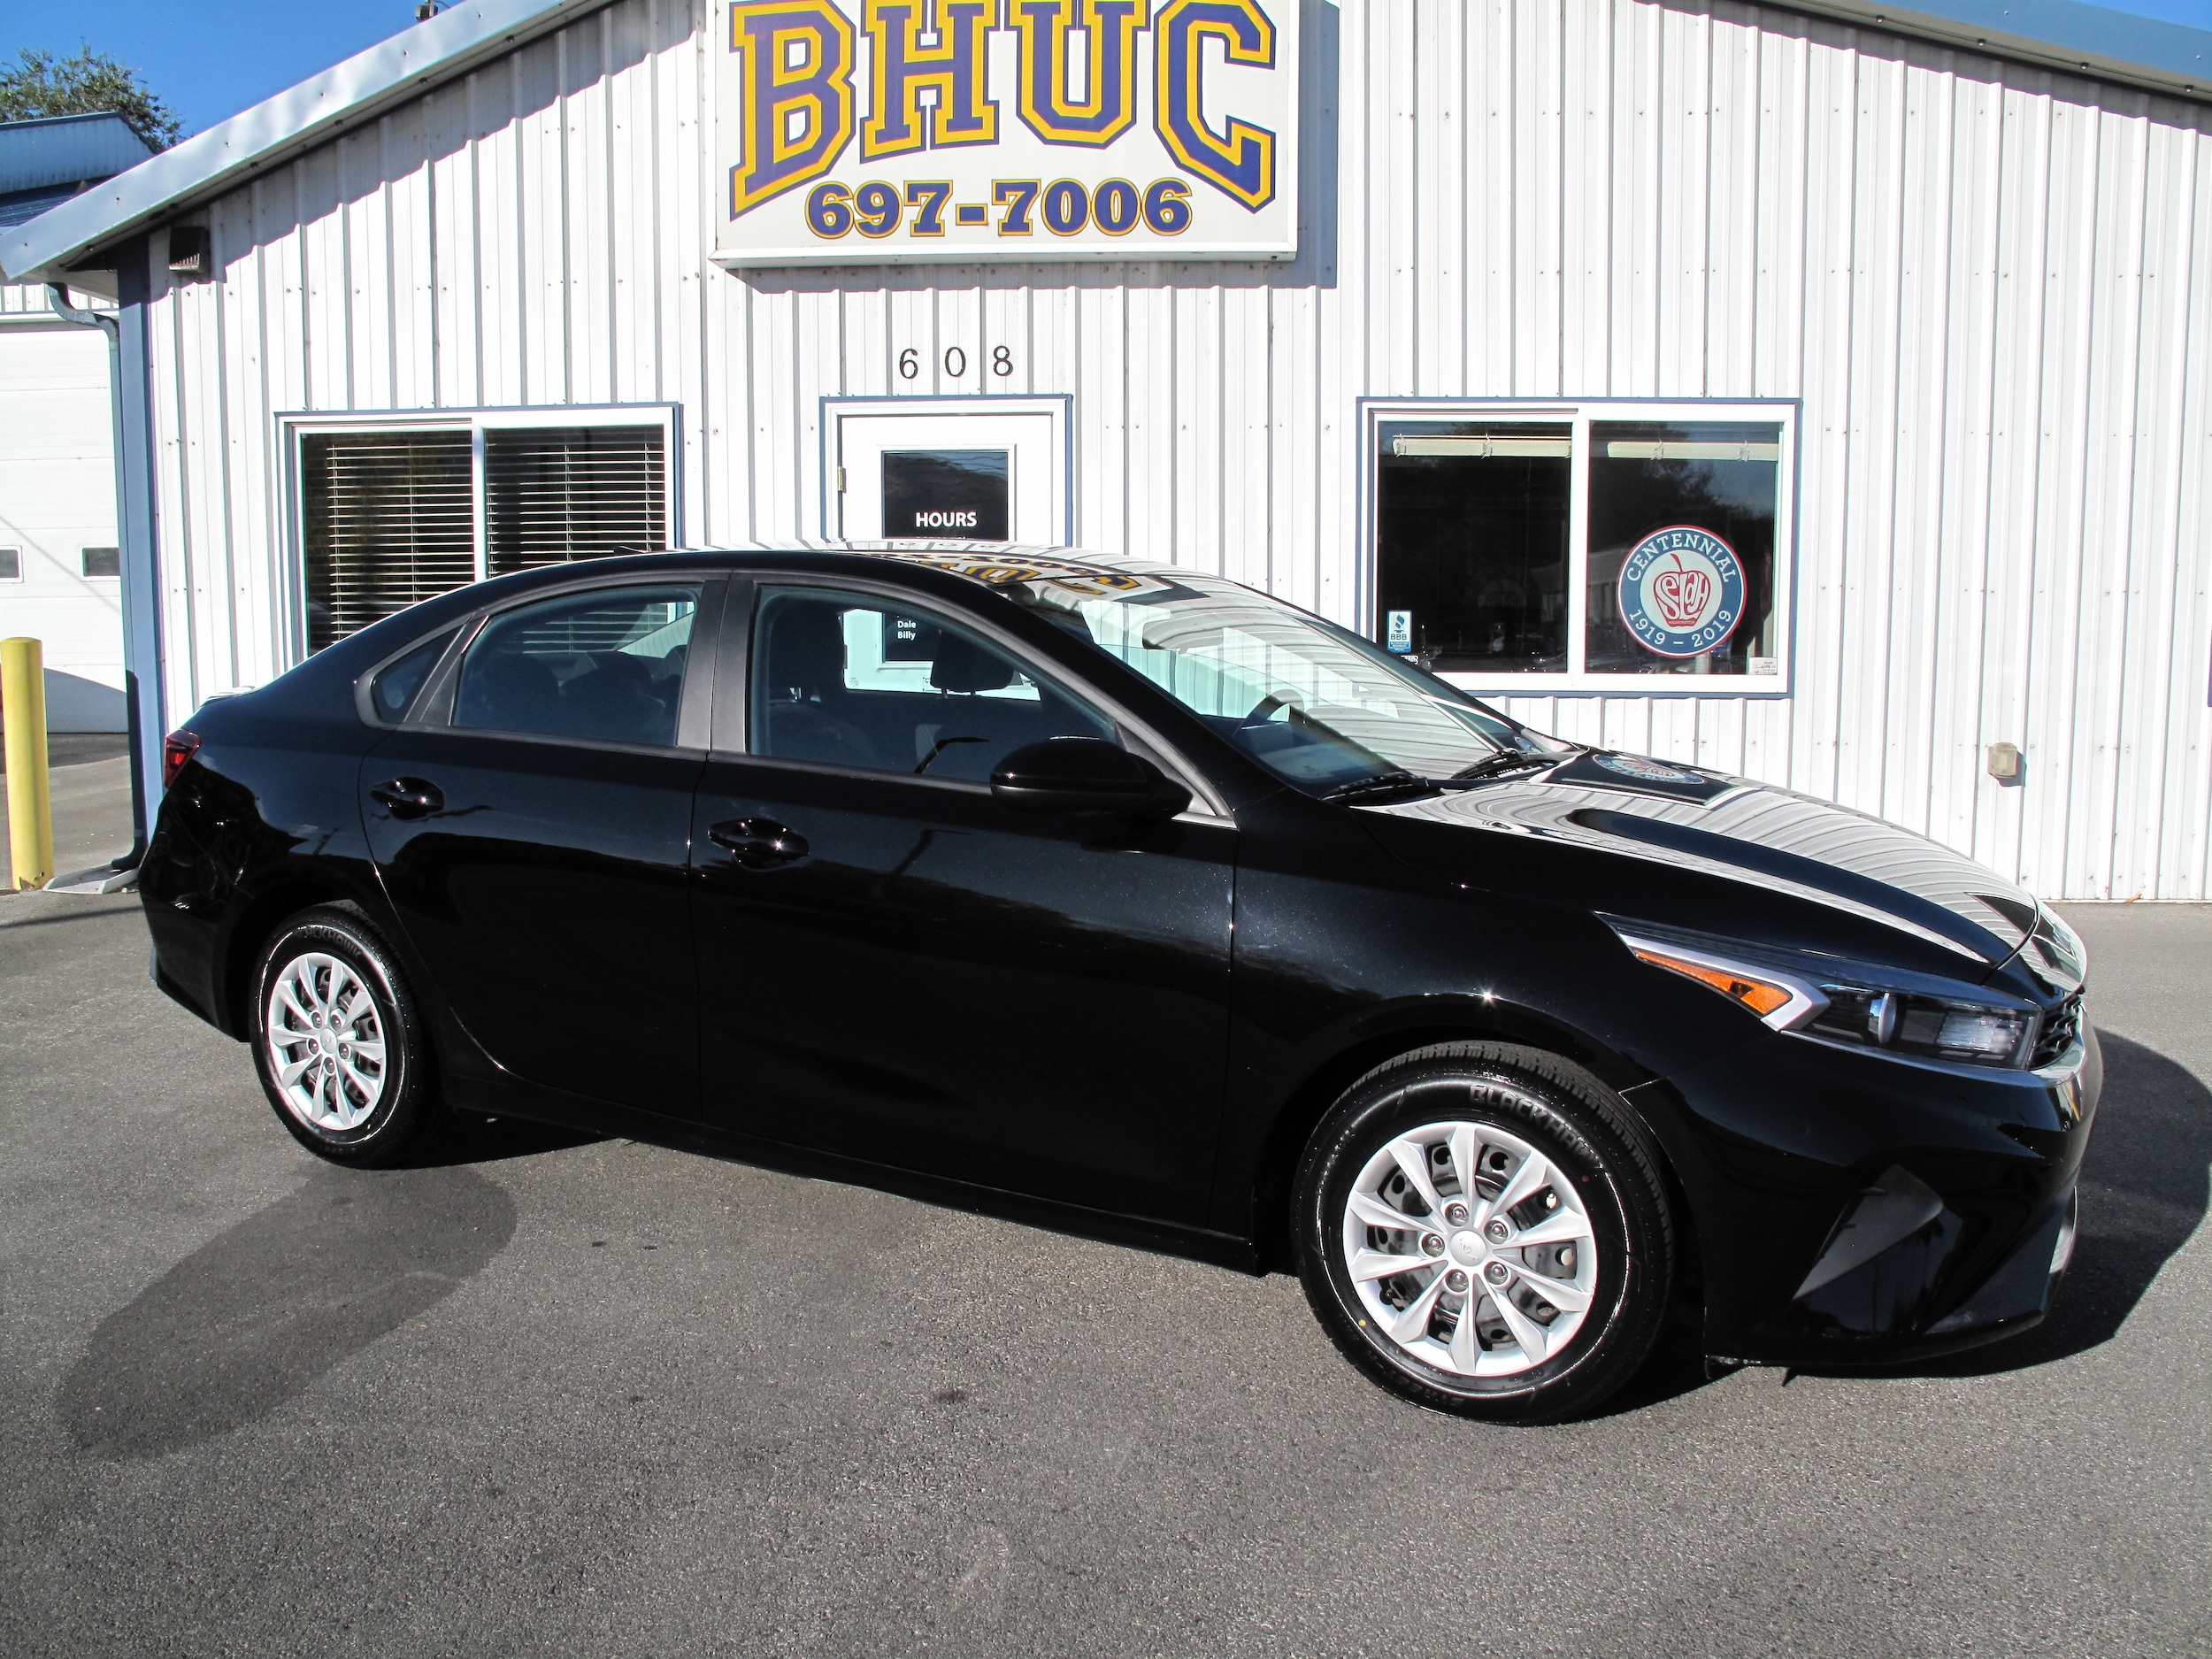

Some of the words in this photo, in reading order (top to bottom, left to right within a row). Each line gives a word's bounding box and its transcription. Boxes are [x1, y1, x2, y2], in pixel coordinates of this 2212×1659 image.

[729, 0, 1276, 221] BHUC
[804, 177, 1193, 239] 697-7006
[898, 345, 1014, 380] 608
[916, 511, 978, 527] HOURS
[1626, 533, 1737, 583] CENTENNIAL
[897, 631, 916, 641] Billy
[1629, 609, 1665, 645] 1919
[1691, 610, 1732, 648] 2019
